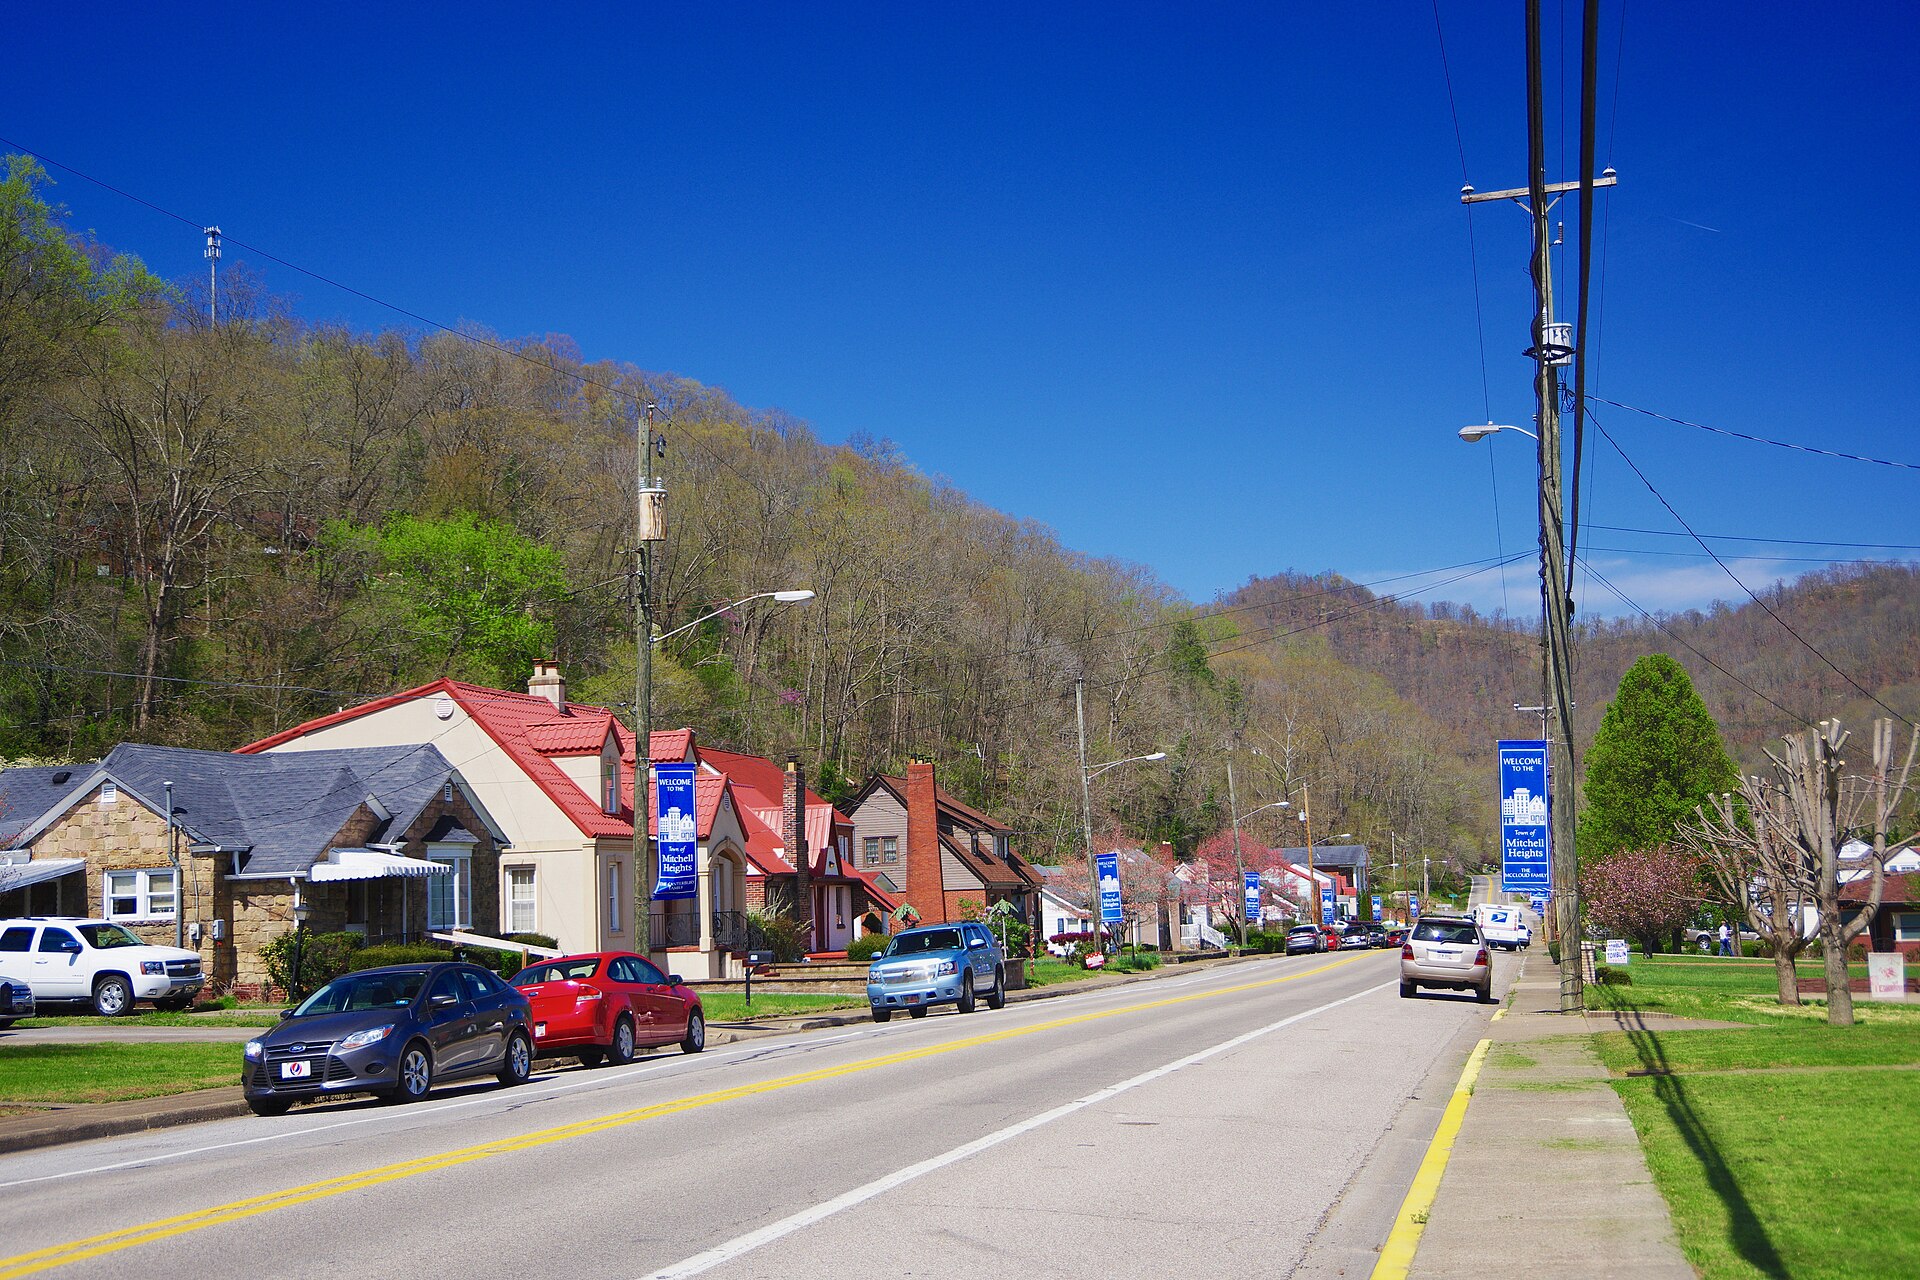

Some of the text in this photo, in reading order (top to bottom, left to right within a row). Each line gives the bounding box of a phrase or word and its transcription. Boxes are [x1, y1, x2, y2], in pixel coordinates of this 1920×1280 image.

[1530, 828, 1536, 838] of
[1506, 838, 1544, 848] Mitchell
[680, 844, 686, 854] of
[1508, 848, 1544, 860] Heights
[662, 854, 694, 862] Mitchell
[664, 864, 692, 874] Heights
